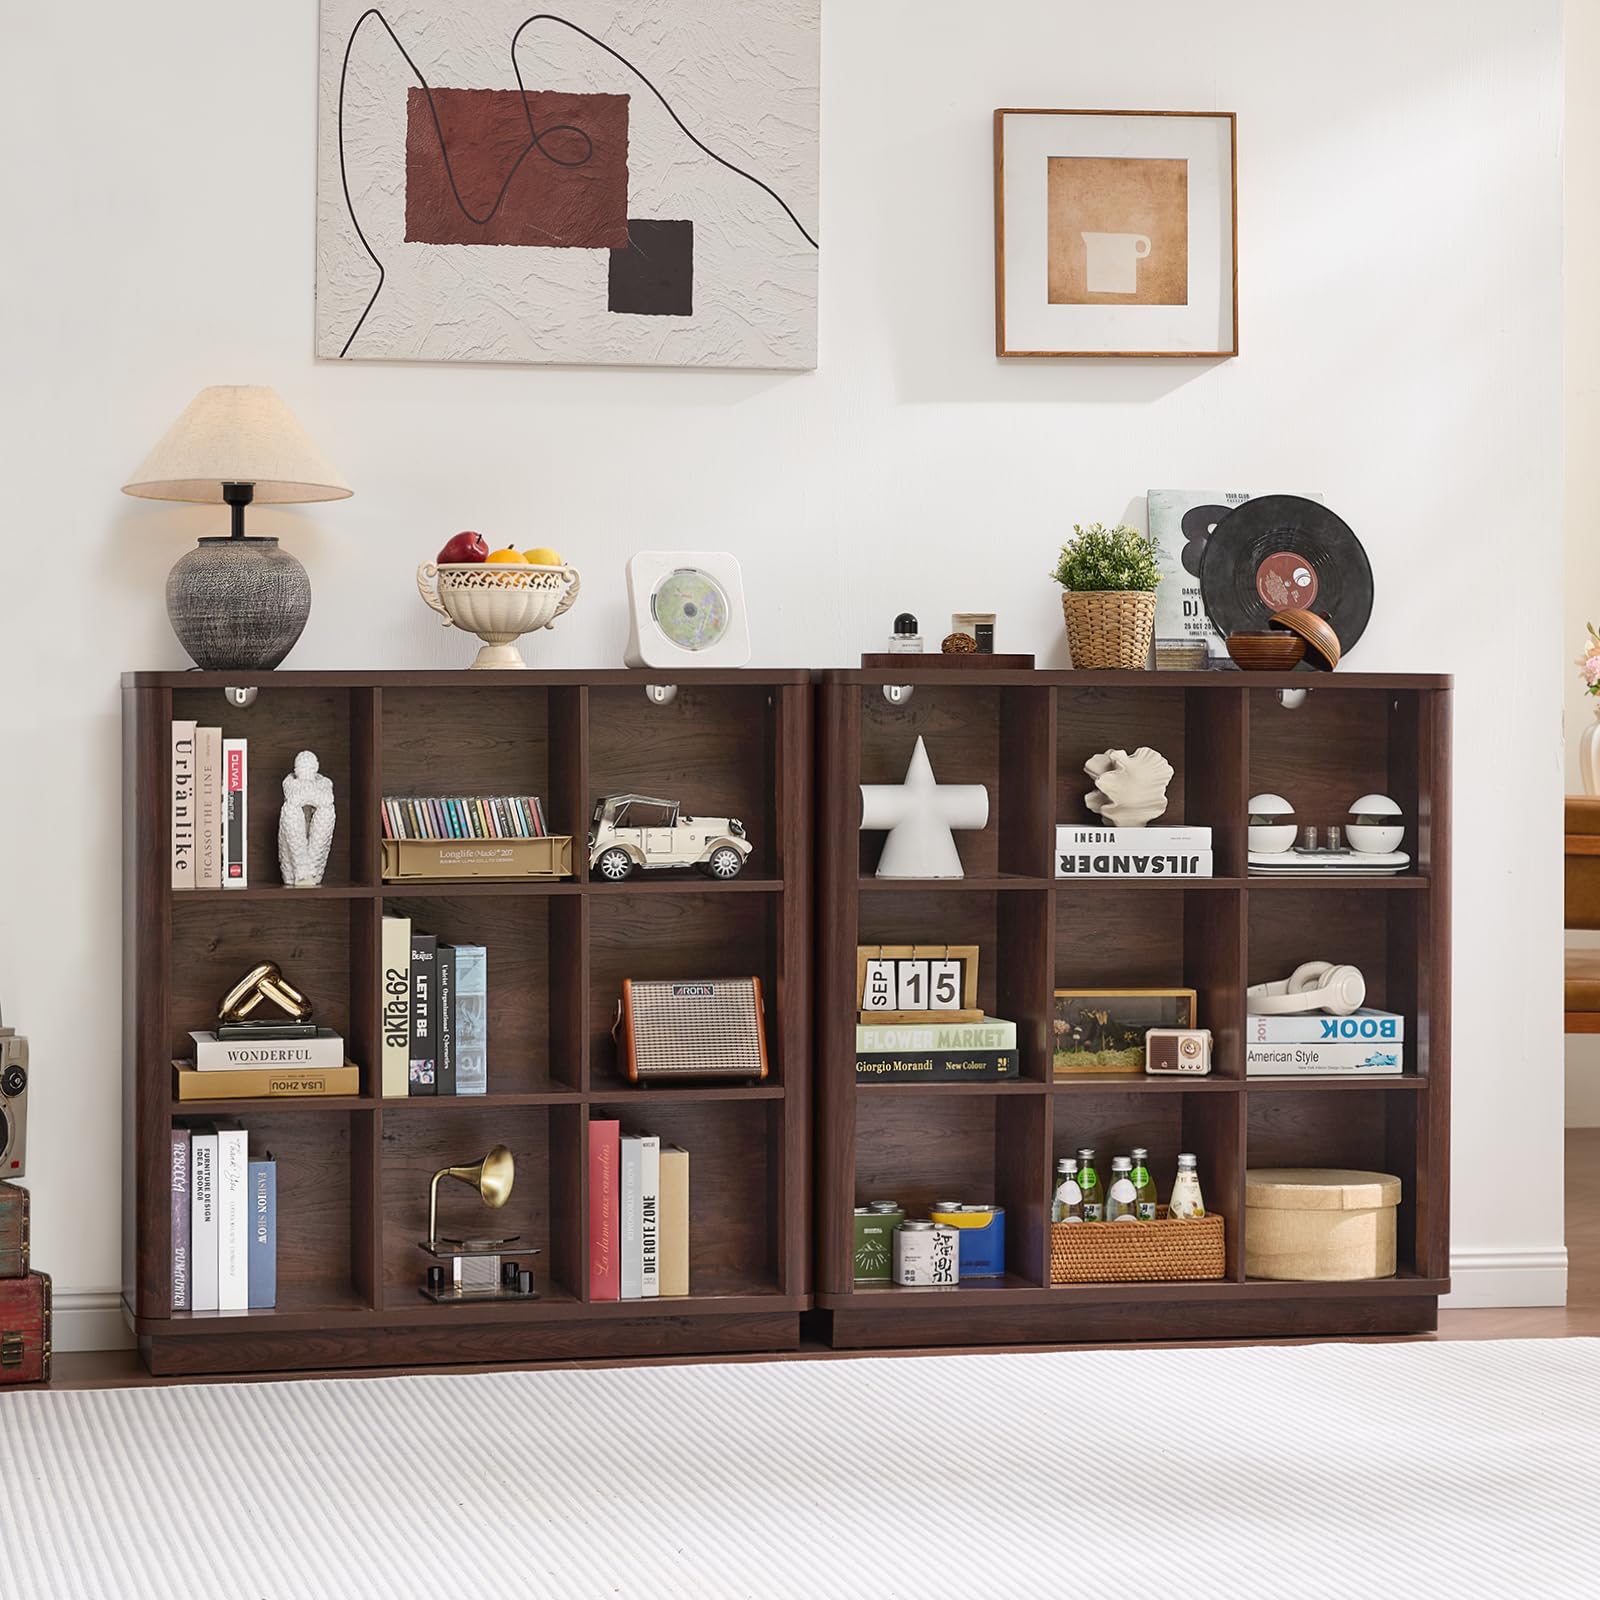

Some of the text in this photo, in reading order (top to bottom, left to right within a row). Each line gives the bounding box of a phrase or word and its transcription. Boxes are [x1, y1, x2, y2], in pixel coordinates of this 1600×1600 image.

[1183, 600, 1198, 617] DJ
[204, 765, 212, 794] LINE
[231, 754, 239, 788] OLIVIA
[175, 739, 193, 871] Urbänlike
[204, 800, 212, 825] THE
[204, 829, 212, 879] PICASSO
[872, 971, 888, 1006] SEP
[906, 973, 956, 1004] 1 5
[416, 975, 428, 1038] LET IT BE
[863, 1029, 1005, 1049] FLOWER MARKET
[1320, 1019, 1396, 1038] BOOK
[228, 1049, 312, 1061] WONDERFUL
[856, 1060, 892, 1073] Giorgio
[893, 1059, 933, 1071] Morandi
[945, 1062, 961, 1070] New
[962, 1061, 987, 1070] Colour
[1248, 1050, 1319, 1065] American Style
[272, 1080, 323, 1090] LISA ZHOU
[172, 1142, 186, 1193] REBECCA
[257, 1172, 268, 1244] FASHION SHOW
[643, 1195, 656, 1223] ZONE
[643, 1226, 656, 1254] ROTE
[643, 1256, 656, 1273] DIE
